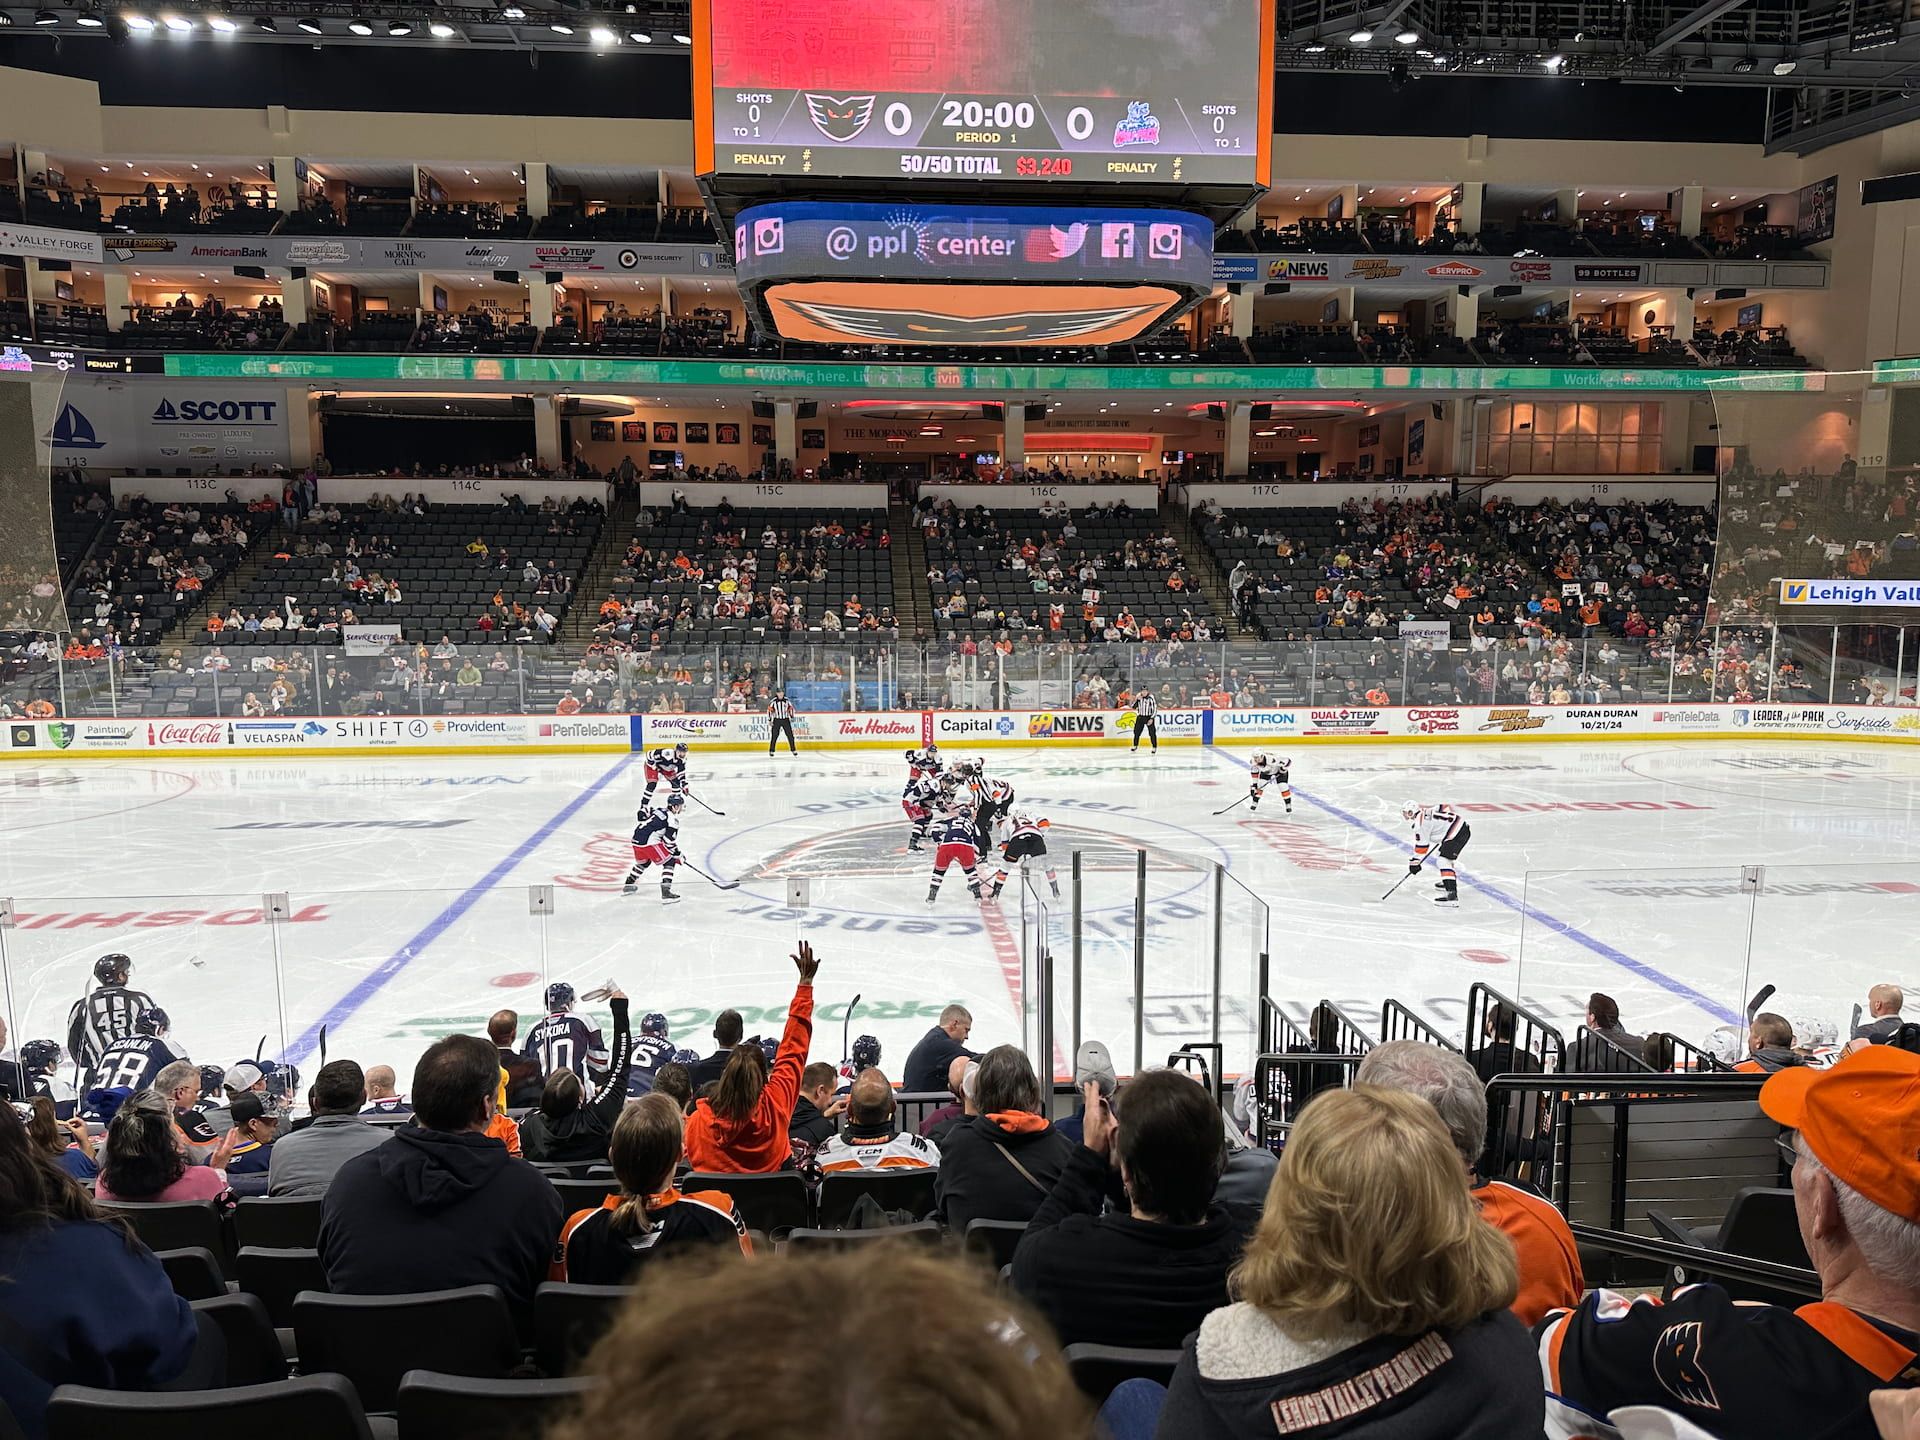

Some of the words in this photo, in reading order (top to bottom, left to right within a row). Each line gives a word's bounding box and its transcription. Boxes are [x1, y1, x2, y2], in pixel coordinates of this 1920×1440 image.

[1855, 28, 1895, 41] MACK
[736, 93, 772, 104] SHOTS
[749, 105, 760, 122] 0
[942, 100, 1035, 129] 20:00
[1202, 105, 1237, 116] SHOTS
[884, 102, 912, 136] 0
[1066, 106, 1094, 140] 0
[1213, 116, 1224, 134] 0
[733, 127, 748, 137] TO
[754, 127, 760, 138] 1
[956, 132, 1001, 144] PERIOD
[1010, 134, 1016, 144] 1
[1215, 139, 1229, 148] TO
[1234, 138, 1241, 148] 1
[734, 155, 786, 166] PENALTY
[901, 155, 952, 174] 50/50
[954, 156, 1001, 175] TOTAL
[1016, 157, 1072, 177] $3,240
[1107, 162, 1158, 174] PENALTY
[16, 235, 56, 248] VALLEY
[60, 240, 94, 252] FORGE
[105, 238, 133, 250] PALLET
[134, 238, 168, 250] EXPRESS
[396, 243, 412, 251] THE
[826, 226, 857, 260] @
[868, 229, 907, 259] ppl
[937, 234, 1015, 256] center
[191, 246, 268, 259] AmericanBank
[384, 250, 425, 259] MORNING
[465, 246, 494, 256] Jani
[535, 247, 560, 256] DUAL
[569, 247, 596, 257] TEMP
[394, 258, 416, 266] CALL
[1268, 259, 1289, 279] 69
[1288, 260, 1328, 276] NEWS
[1436, 266, 1473, 275] SERVPRO
[1578, 269, 1592, 278] 99
[1594, 269, 1637, 278] BOTTLES
[1212, 272, 1234, 280] IRPORT
[480, 299, 498, 307] THE
[49, 351, 75, 359] SHOTS
[87, 360, 118, 369] PENALTY
[760, 370, 814, 385] Working
[817, 369, 846, 384] here.
[1564, 374, 1609, 387] Working
[179, 401, 276, 421] SCOTT
[844, 428, 865, 439] THE
[869, 428, 917, 439] MORNING
[65, 456, 87, 466] 113
[1861, 456, 1883, 466] 119
[186, 479, 217, 490] 113C
[452, 480, 481, 491] 114C
[756, 485, 784, 496] 115C
[1252, 485, 1279, 495] 117C
[1390, 484, 1408, 494] 117
[1591, 484, 1609, 494] 118
[1030, 487, 1057, 497] 116C
[1810, 585, 1876, 604] Lehigh
[346, 633, 371, 643] SERVICE
[1400, 629, 1422, 638] SERVICE
[1422, 628, 1448, 637] ELECTRIC
[1232, 713, 1294, 725] LUTRON
[1311, 710, 1338, 722] DUAL
[1350, 710, 1380, 722] TEMP
[1488, 708, 1529, 721] IRONTON
[1566, 710, 1601, 719] DURAN
[1603, 709, 1638, 718] DURAN
[1753, 710, 1783, 722] LEADER
[1790, 711, 1801, 721] the
[1802, 711, 1825, 723] PACK
[651, 717, 687, 729] SERVICE
[689, 717, 727, 729] ELECTRIC
[838, 719, 862, 735] Tim
[864, 718, 916, 735] Hortons
[941, 718, 993, 735] Capital
[1029, 713, 1053, 734] 69
[1053, 716, 1104, 732] NEWS
[1581, 720, 1623, 731] 10/21/24
[1827, 710, 1892, 731] Surfside
[87, 725, 126, 737] Painting
[336, 721, 404, 737] SHIFT
[448, 721, 506, 733] Provident
[1161, 726, 1195, 734] Allentown
[1231, 726, 1245, 734] Light
[244, 733, 305, 743] VELASPAN
[1440, 800, 1715, 812] TOSHIB
[97, 1011, 128, 1031] 45
[535, 1022, 571, 1042] SYKORA
[110, 1036, 153, 1052] SCANLIN
[537, 1038, 574, 1078] 10
[614, 1031, 629, 1075] EXPLORING
[92, 1052, 150, 1090] 58
[857, 1147, 882, 1156] CCM
[1270, 1392, 1332, 1435] LEHIGH
[1319, 1370, 1383, 1421] VALLEY
[1372, 1330, 1454, 1400] PHANTOMS
